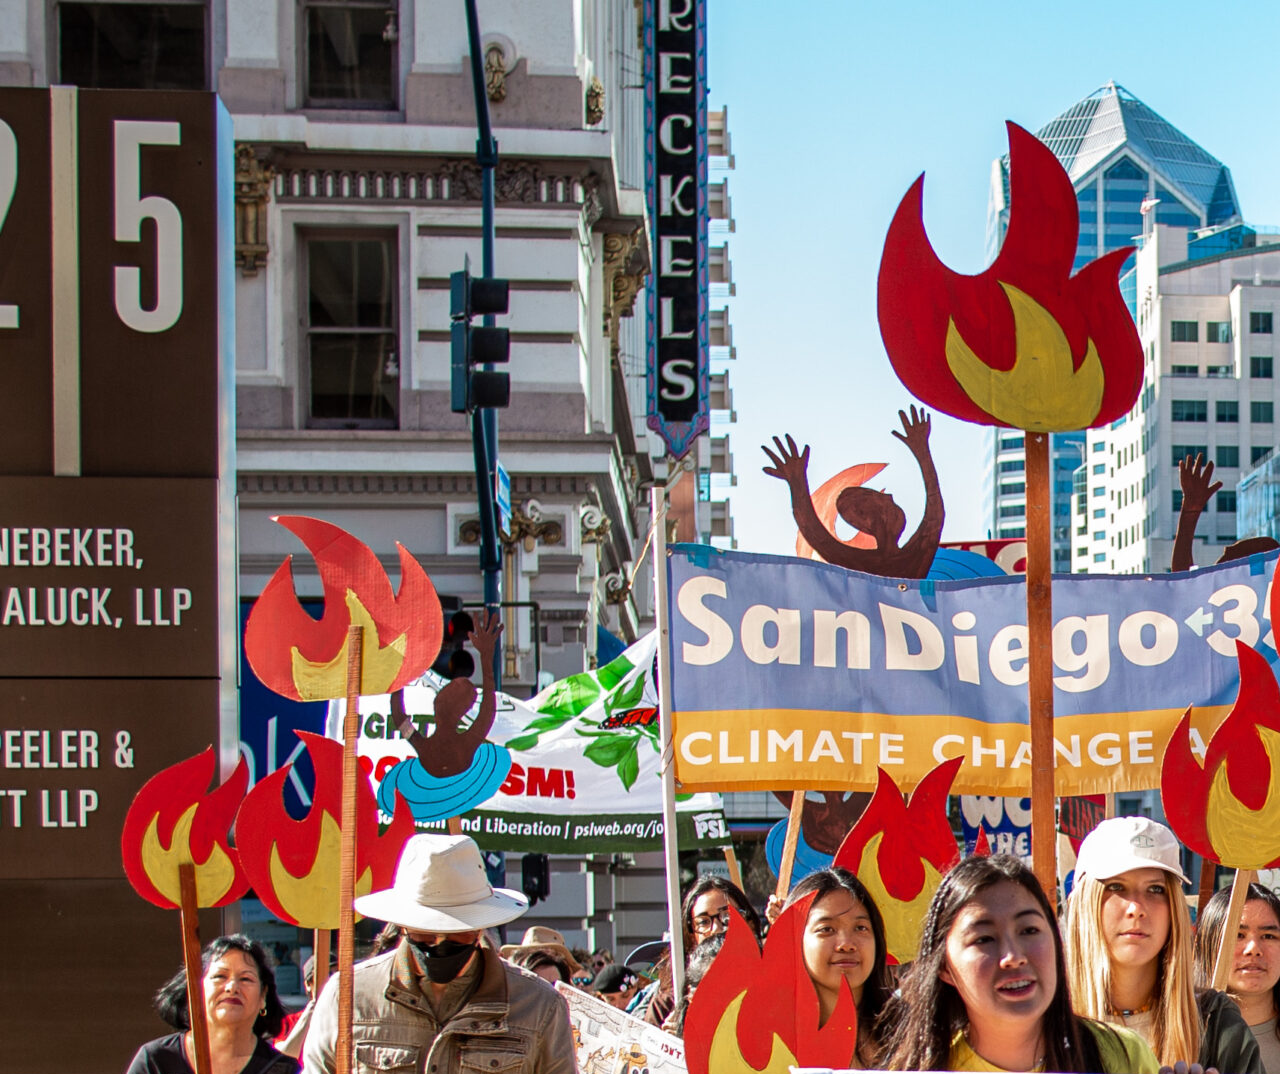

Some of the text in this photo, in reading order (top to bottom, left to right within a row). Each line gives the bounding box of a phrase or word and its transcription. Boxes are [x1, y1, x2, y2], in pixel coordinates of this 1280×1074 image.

[136, 588, 192, 626] LLP
[677, 576, 1180, 693] SanDiego
[0, 730, 134, 769] EELER &
[680, 730, 905, 766] CLIMATE
[932, 730, 1155, 768] CHANGE
[42, 790, 98, 828] LLP
[485, 817, 562, 837] Liberation
[574, 820, 664, 840] pslweb.org/jo
[695, 819, 730, 839] PSL
